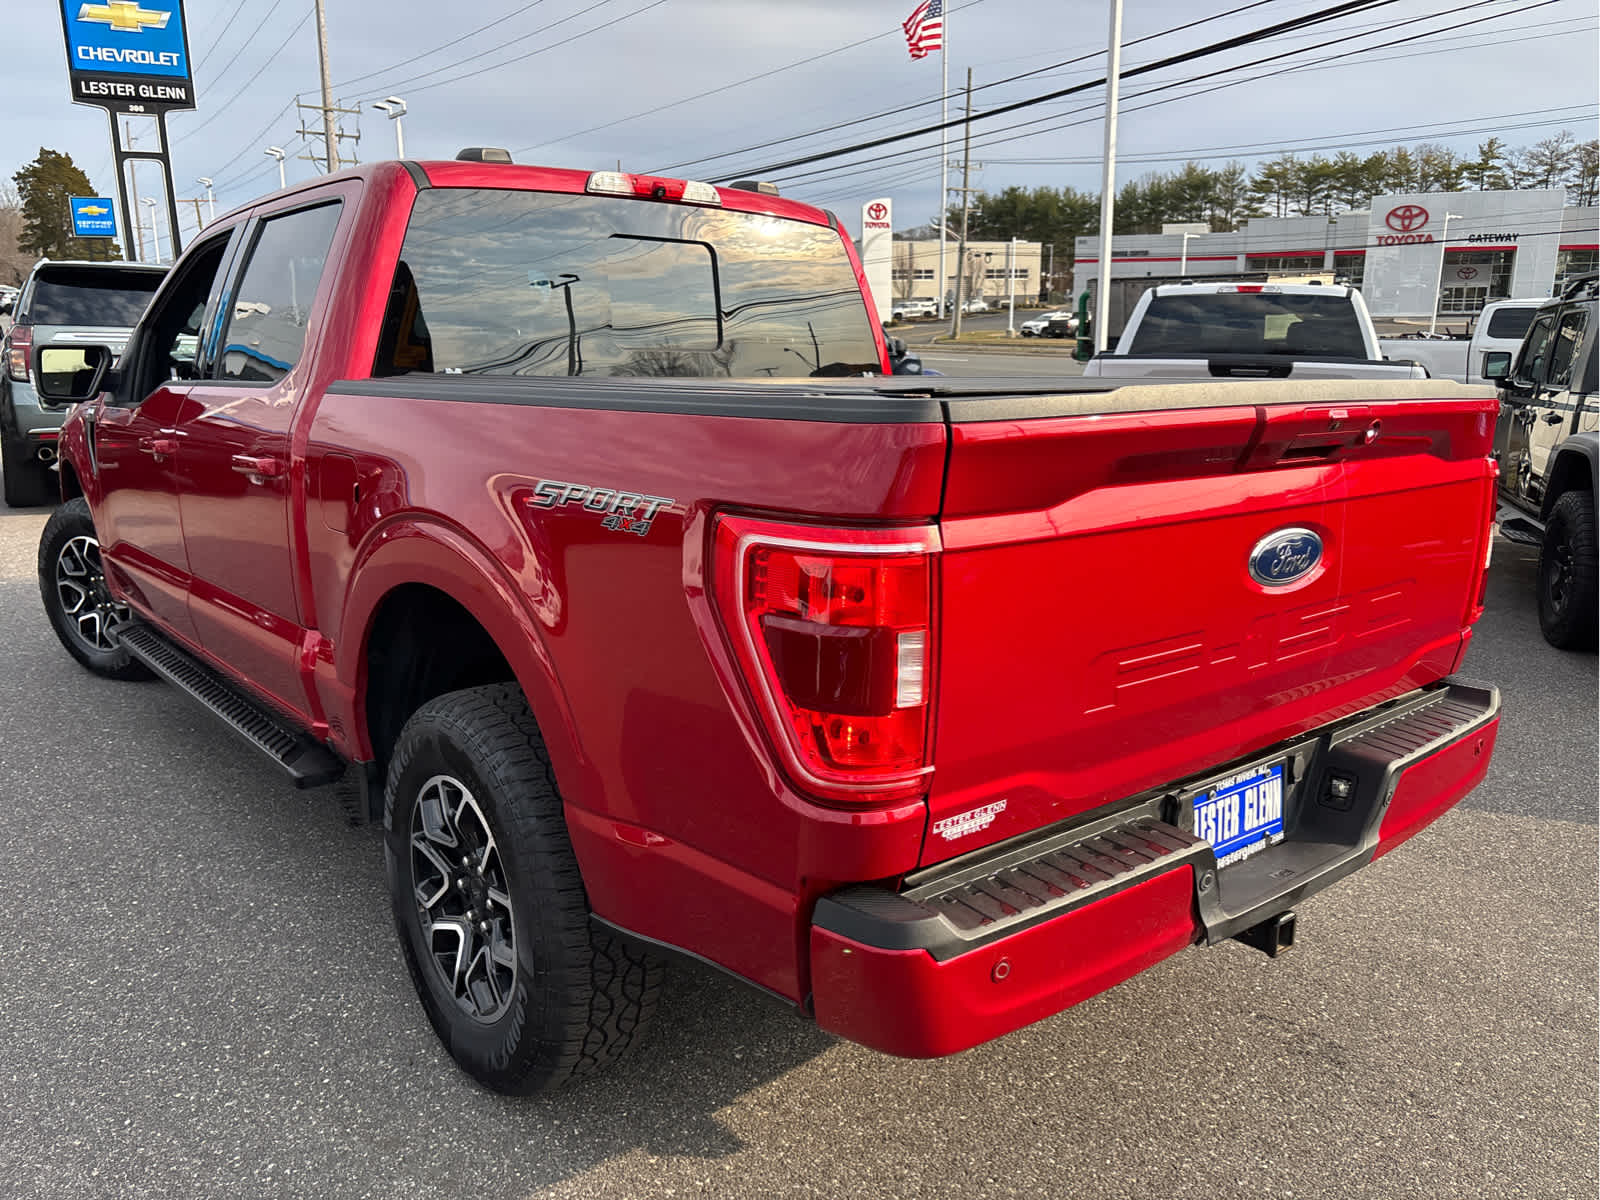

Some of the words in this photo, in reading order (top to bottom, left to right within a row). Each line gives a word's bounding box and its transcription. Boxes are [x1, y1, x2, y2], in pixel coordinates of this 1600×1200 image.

[77, 46, 180, 66] CHEVROLET
[81, 81, 135, 97] LESTER
[139, 85, 186, 100] GLENN
[1376, 234, 1434, 246] TOYOTA
[1468, 233, 1520, 243] GATEWAY
[526, 479, 675, 521] SPORT
[1272, 541, 1311, 575] Ford
[933, 813, 972, 834] LESTER
[974, 799, 1008, 818] GLENN
[1194, 793, 1240, 846] LESTER
[1244, 778, 1281, 831] GLENN
